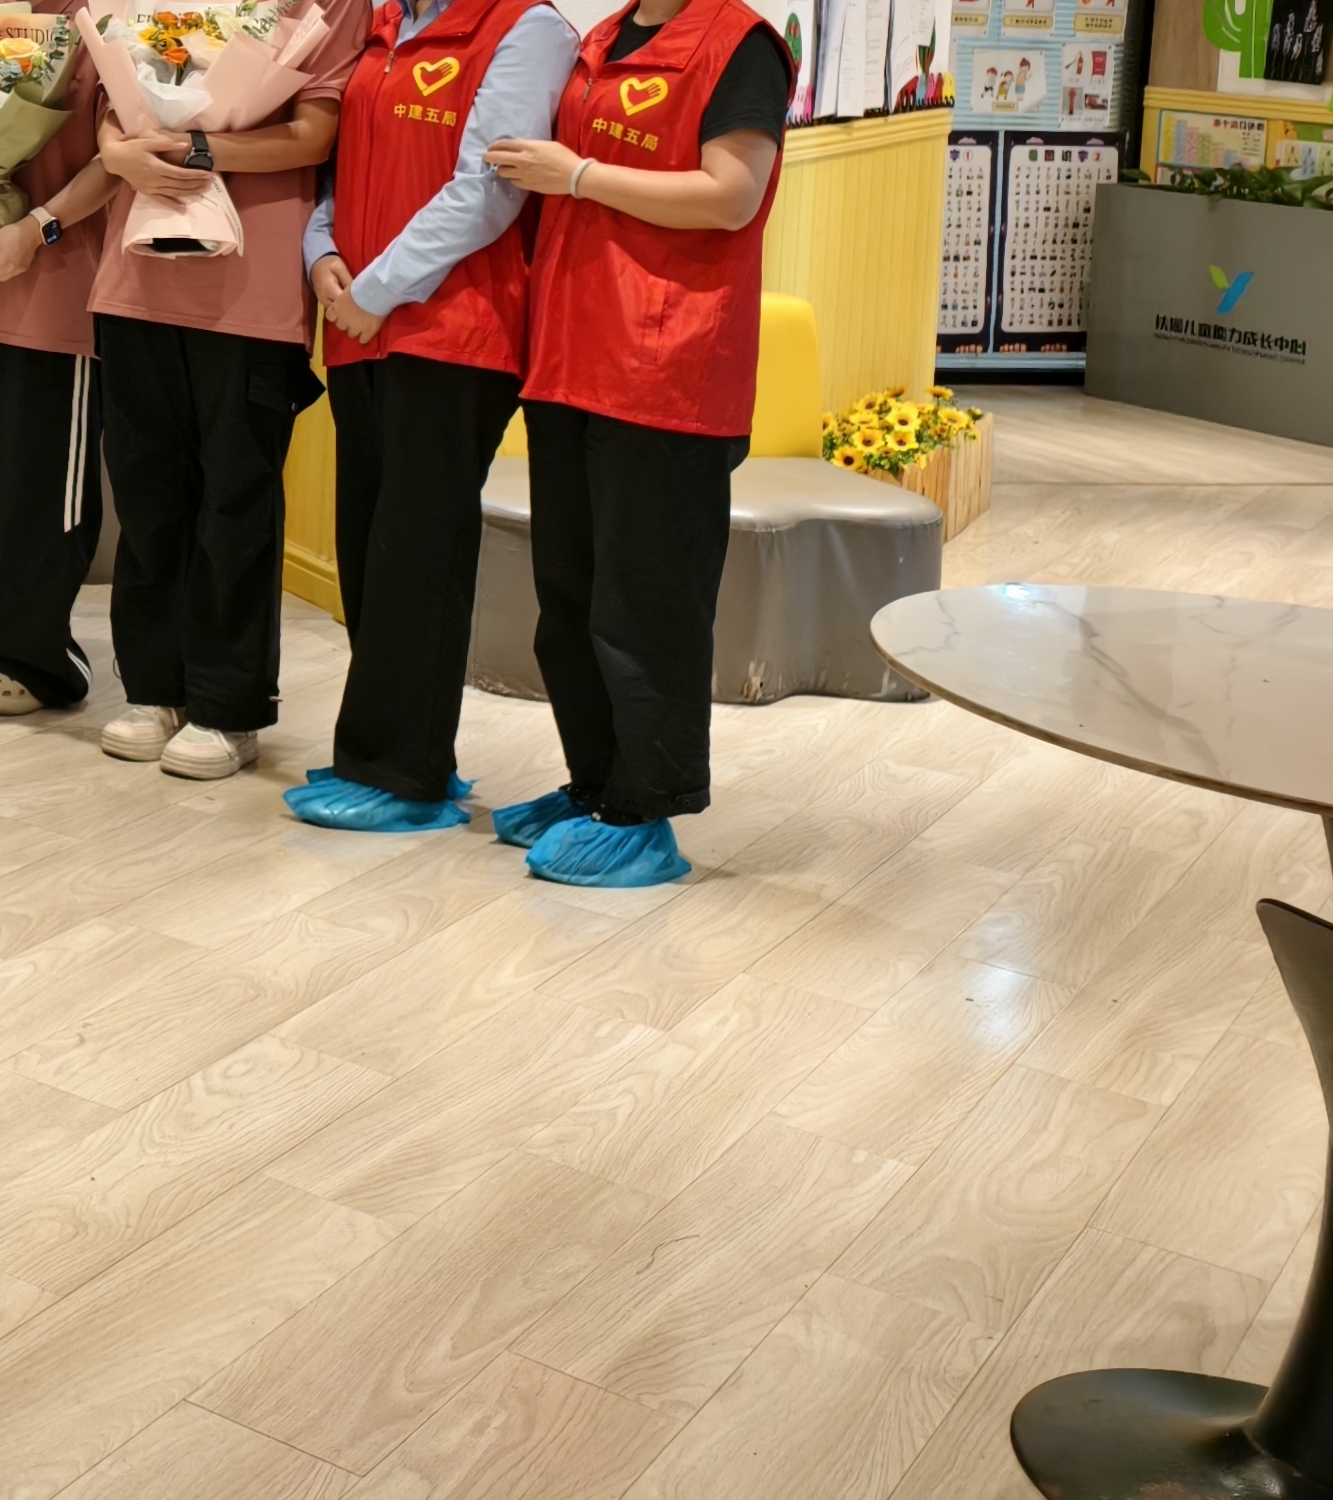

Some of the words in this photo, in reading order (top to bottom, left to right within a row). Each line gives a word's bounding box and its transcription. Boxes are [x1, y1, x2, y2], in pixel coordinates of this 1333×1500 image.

[393, 103, 457, 128] 中建五局
[591, 117, 659, 152] 中建五局
[1155, 313, 1307, 356] 扶摇儿童能力成长中心
